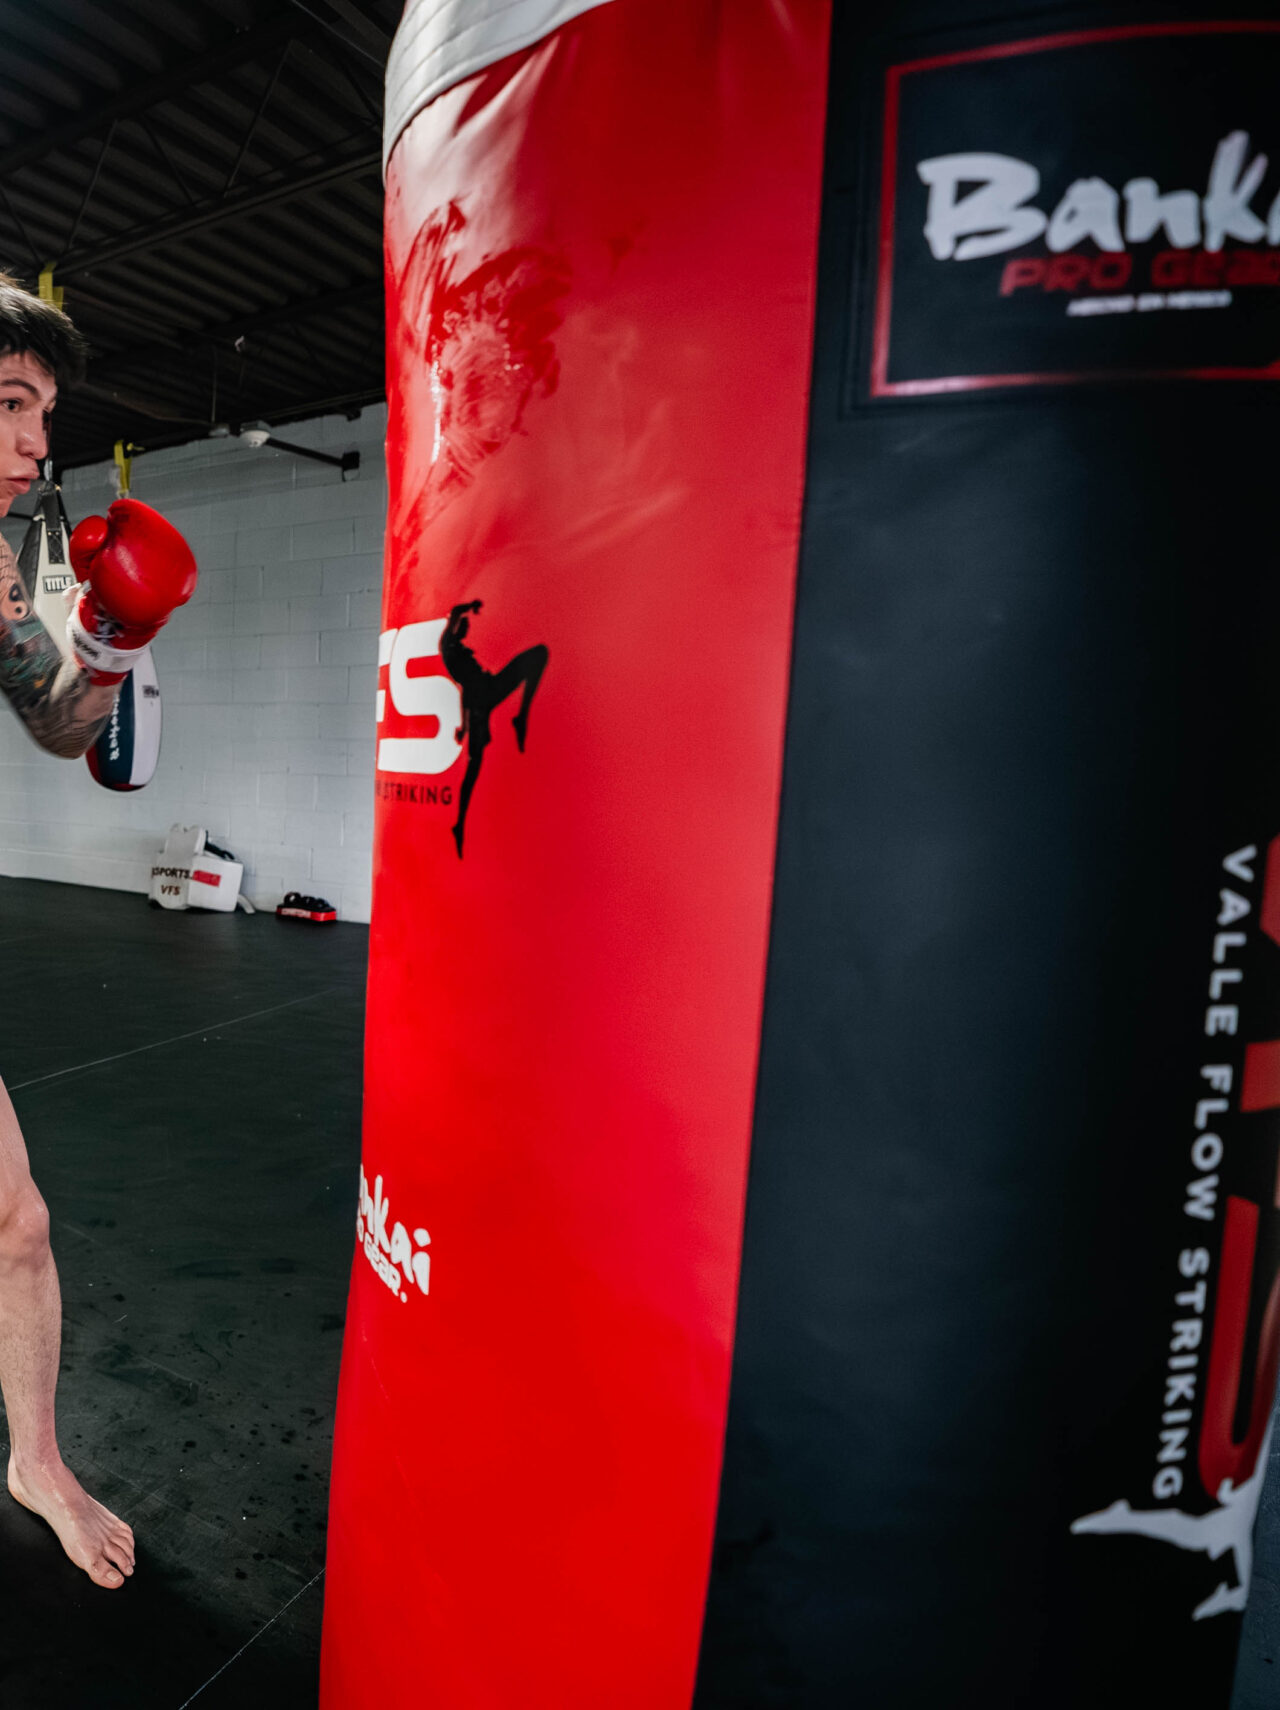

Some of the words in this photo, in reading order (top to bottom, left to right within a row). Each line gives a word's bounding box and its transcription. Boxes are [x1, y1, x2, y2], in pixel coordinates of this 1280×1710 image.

[916, 130, 1280, 261] Bank
[999, 251, 1133, 297] PRO
[1204, 844, 1258, 1037] VALLE
[1183, 1063, 1234, 1222] FLOW
[1152, 1246, 1211, 1500] STRIKING
